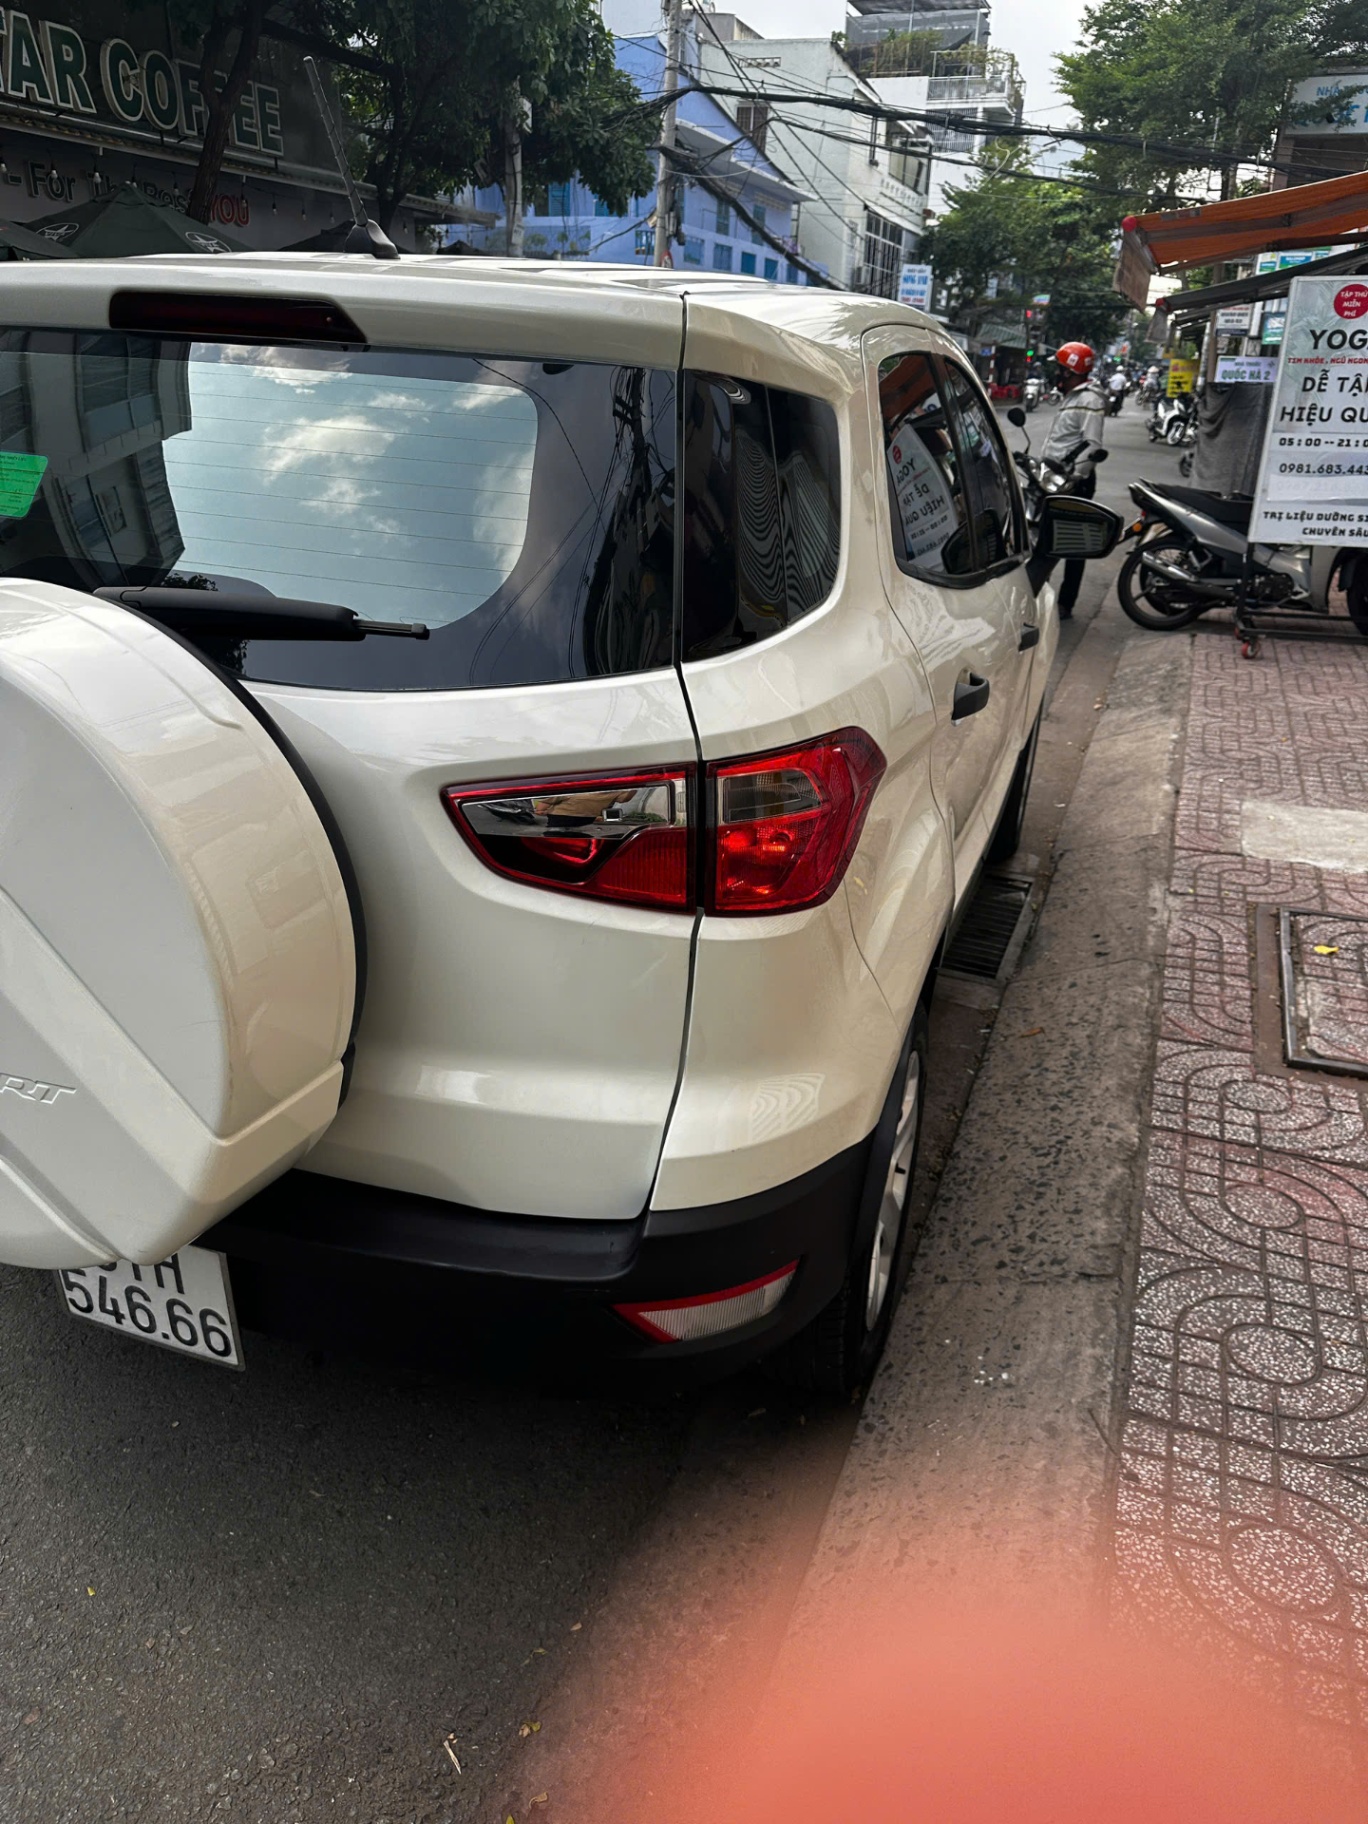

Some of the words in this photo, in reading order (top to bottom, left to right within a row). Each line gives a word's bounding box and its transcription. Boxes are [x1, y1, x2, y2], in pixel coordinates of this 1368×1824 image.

[101, 37, 284, 156] COFEE
[28, 160, 76, 202] For
[1342, 298, 1361, 307] MIỄN
[1343, 309, 1357, 317] PHÍ
[1310, 329, 1368, 350] YOG
[1221, 367, 1247, 380] QUỐC
[1263, 370, 1271, 381] 2
[1302, 368, 1330, 392] DỄ
[1337, 373, 1368, 397] TẬ
[1280, 403, 1333, 427] HIỆU
[1263, 511, 1284, 522] TRỊ
[1285, 510, 1314, 522] LIỆU
[1302, 526, 1346, 537] CHUYÊN
[61, 1268, 232, 1358] 546.66
